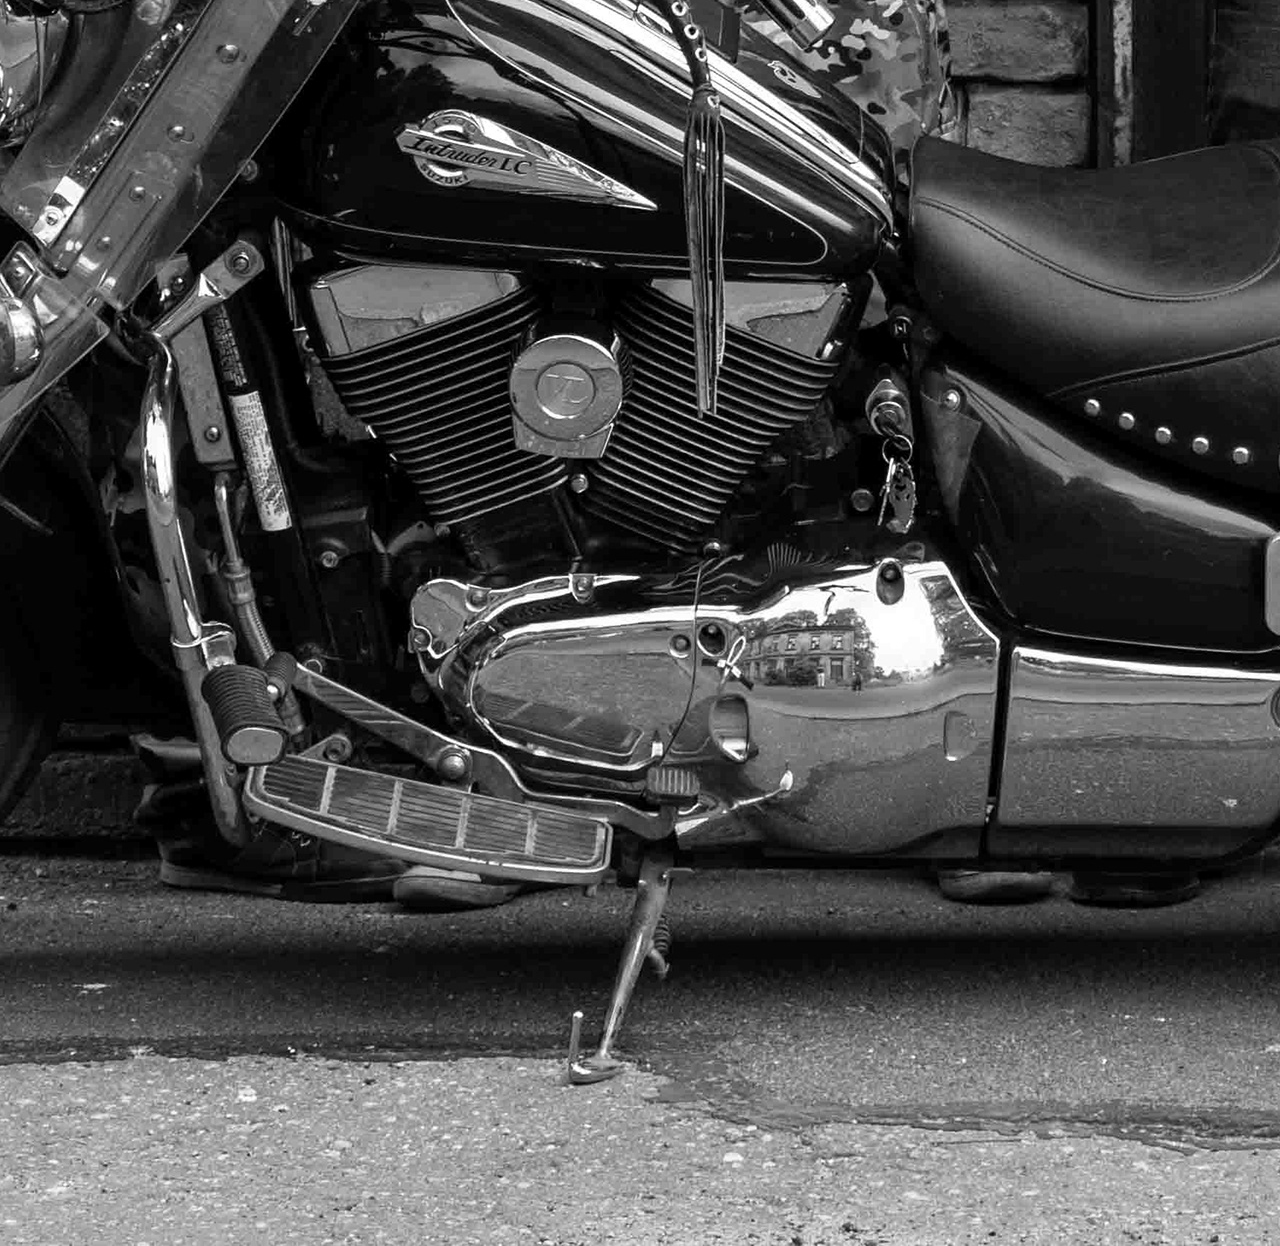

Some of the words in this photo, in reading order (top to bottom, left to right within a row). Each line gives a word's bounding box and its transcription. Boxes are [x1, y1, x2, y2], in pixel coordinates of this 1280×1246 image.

[405, 136, 497, 168] Intruder
[500, 156, 533, 175] LC
[420, 162, 469, 184] SUZUKI
